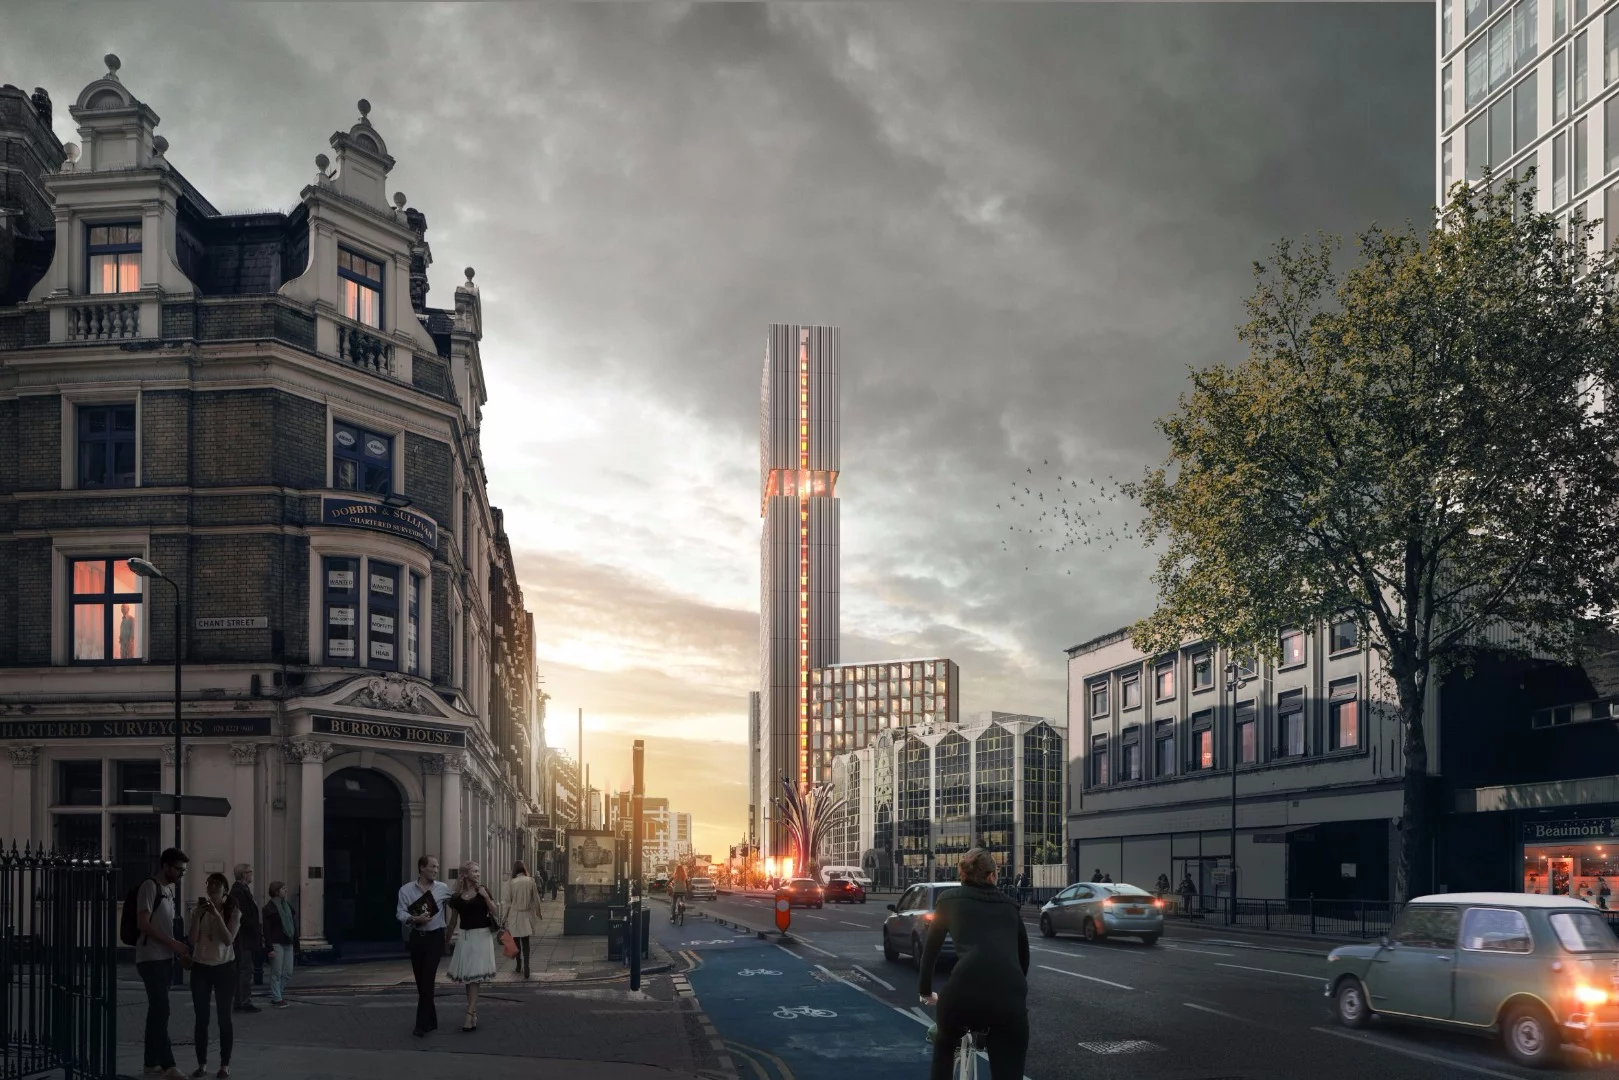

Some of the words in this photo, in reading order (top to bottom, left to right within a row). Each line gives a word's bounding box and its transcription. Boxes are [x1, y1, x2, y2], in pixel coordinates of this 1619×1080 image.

[331, 505, 377, 518] DOBBIN
[382, 508, 390, 516] &
[393, 509, 433, 540] SULLIVAN
[349, 516, 391, 529] CHARTERED
[392, 525, 424, 539] SURVEYORS
[371, 583, 393, 592] WANTED
[198, 619, 224, 627] CHANT
[227, 618, 255, 626] STREET
[0, 723, 92, 737] HARTERED
[331, 720, 401, 738] BURROWS
[406, 728, 451, 744] HOUSE
[1535, 824, 1605, 837] Beaumont
